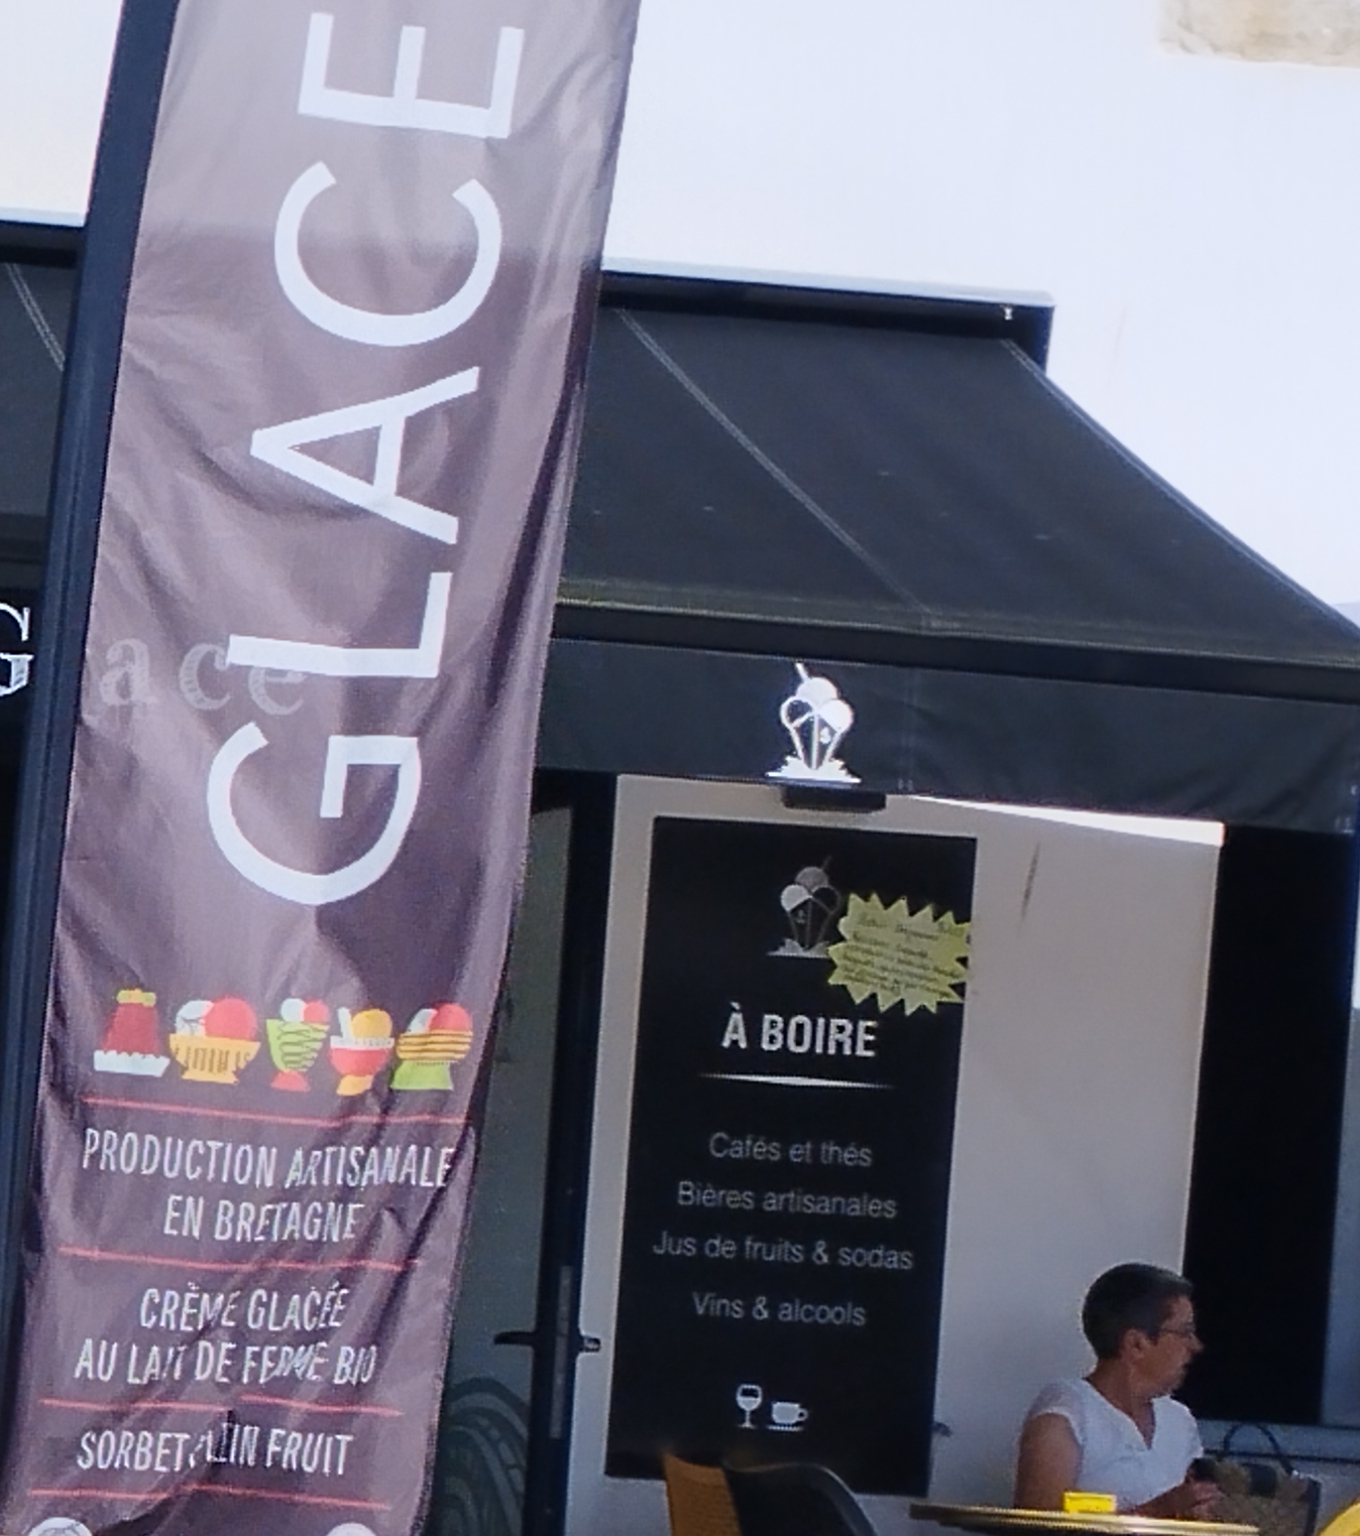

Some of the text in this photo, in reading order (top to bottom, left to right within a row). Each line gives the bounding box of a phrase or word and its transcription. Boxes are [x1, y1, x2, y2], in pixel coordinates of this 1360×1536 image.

[206, 11, 524, 906] GLACE
[721, 1001, 879, 1057] À BOIRE
[82, 1127, 455, 1190] PRODUCTION ARTISANALE
[708, 1131, 873, 1167] Cafés et thés
[163, 1194, 365, 1243] EN BRETAGNE
[676, 1180, 899, 1219] Bières artisanales
[653, 1229, 914, 1270] Jus de fruits & sodas
[139, 1281, 351, 1332] CRÈME GLACÉE
[692, 1291, 867, 1326] Vins & alcools
[73, 1337, 118, 1382] AU
[126, 1343, 188, 1385] LAIT
[194, 1339, 237, 1384] DE
[333, 1345, 378, 1387] BIO
[76, 1430, 191, 1473] SORBET
[265, 1427, 355, 1477] FRUIT
